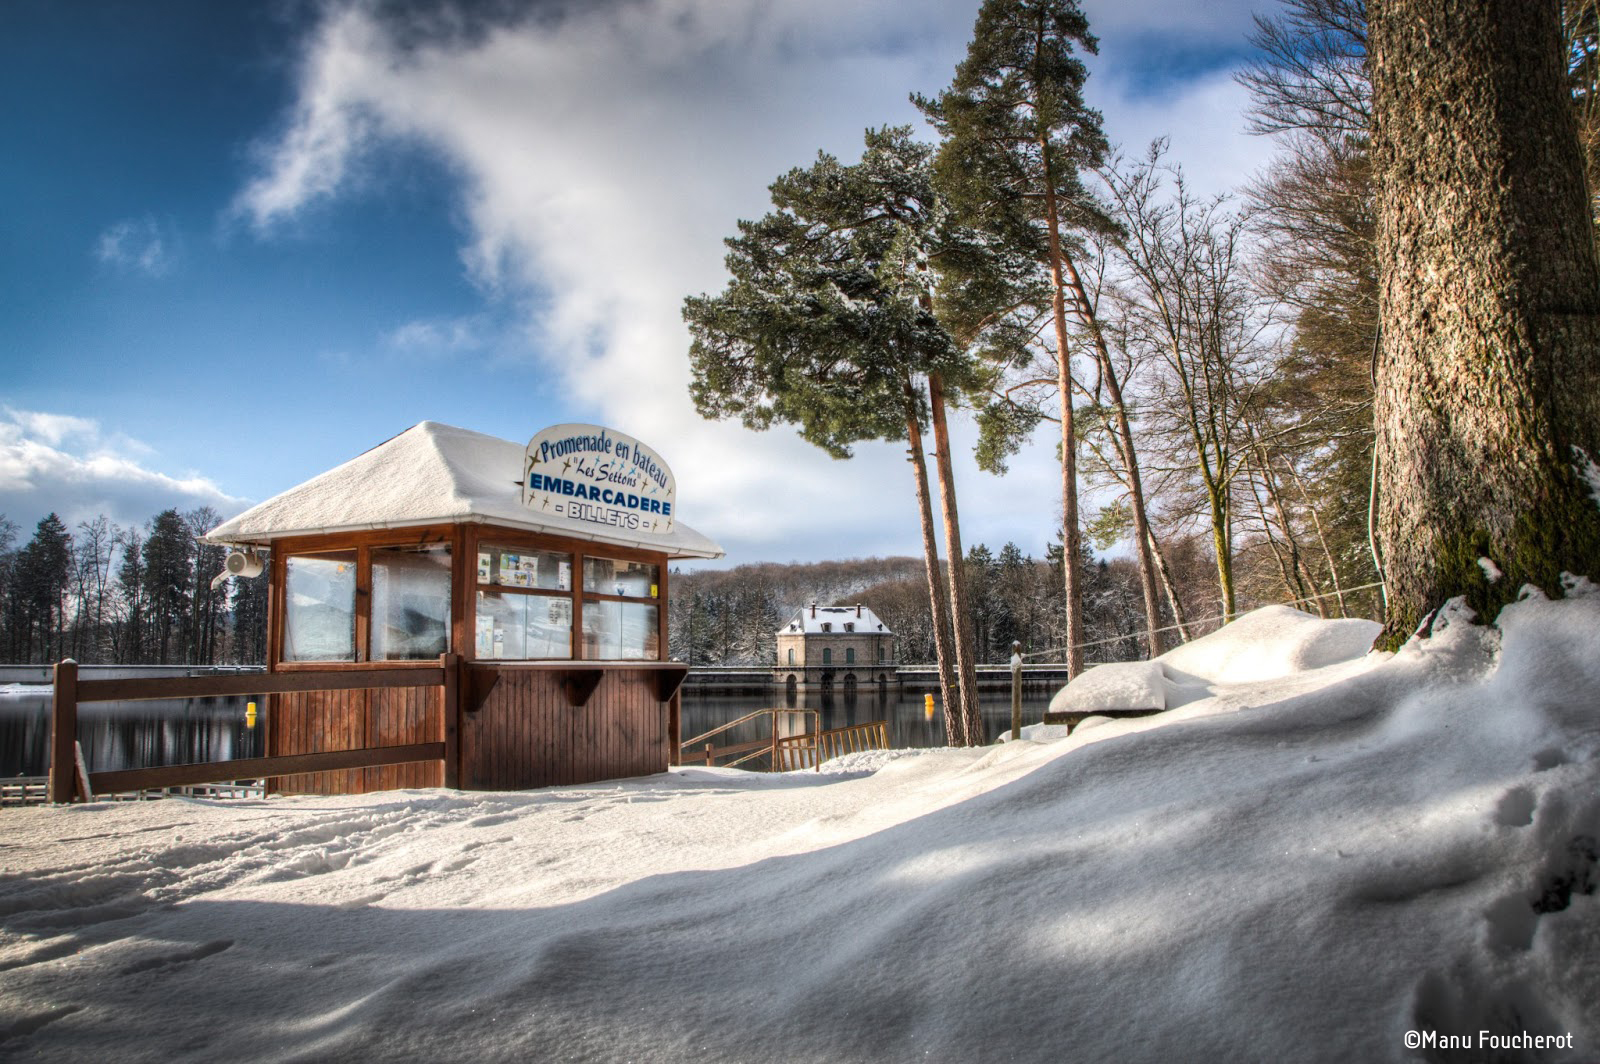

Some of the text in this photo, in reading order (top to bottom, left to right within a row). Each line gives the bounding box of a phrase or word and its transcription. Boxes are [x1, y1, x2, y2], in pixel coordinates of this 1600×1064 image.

[540, 430, 667, 489] Promenade en bateau
[530, 472, 671, 516] EMBARCADERE
[568, 501, 639, 529] BILLETS
